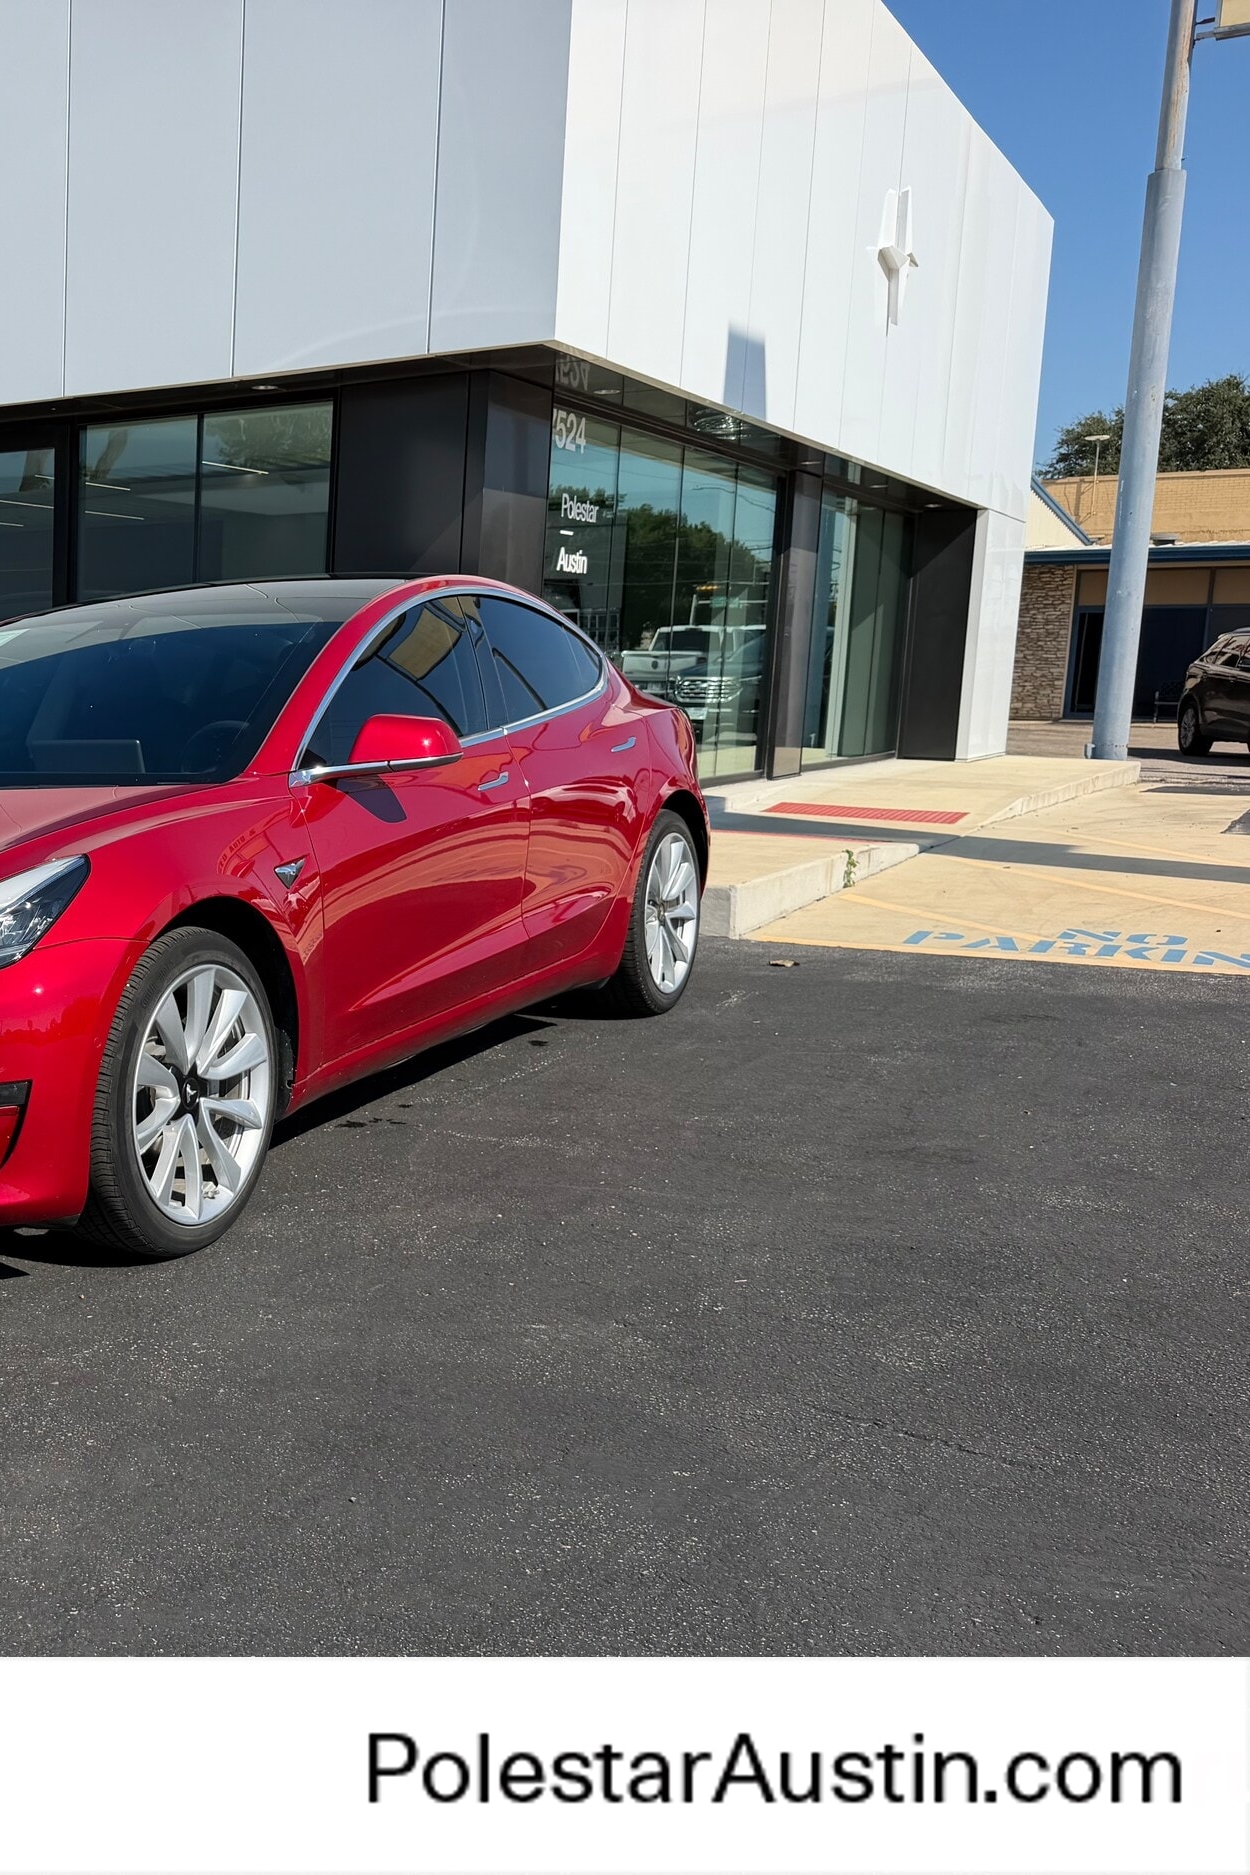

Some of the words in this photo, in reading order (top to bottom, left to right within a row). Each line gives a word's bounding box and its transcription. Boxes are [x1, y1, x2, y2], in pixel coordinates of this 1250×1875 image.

[561, 493, 599, 523] Polestar
[556, 547, 588, 574] Austin
[1057, 928, 1188, 946] NO
